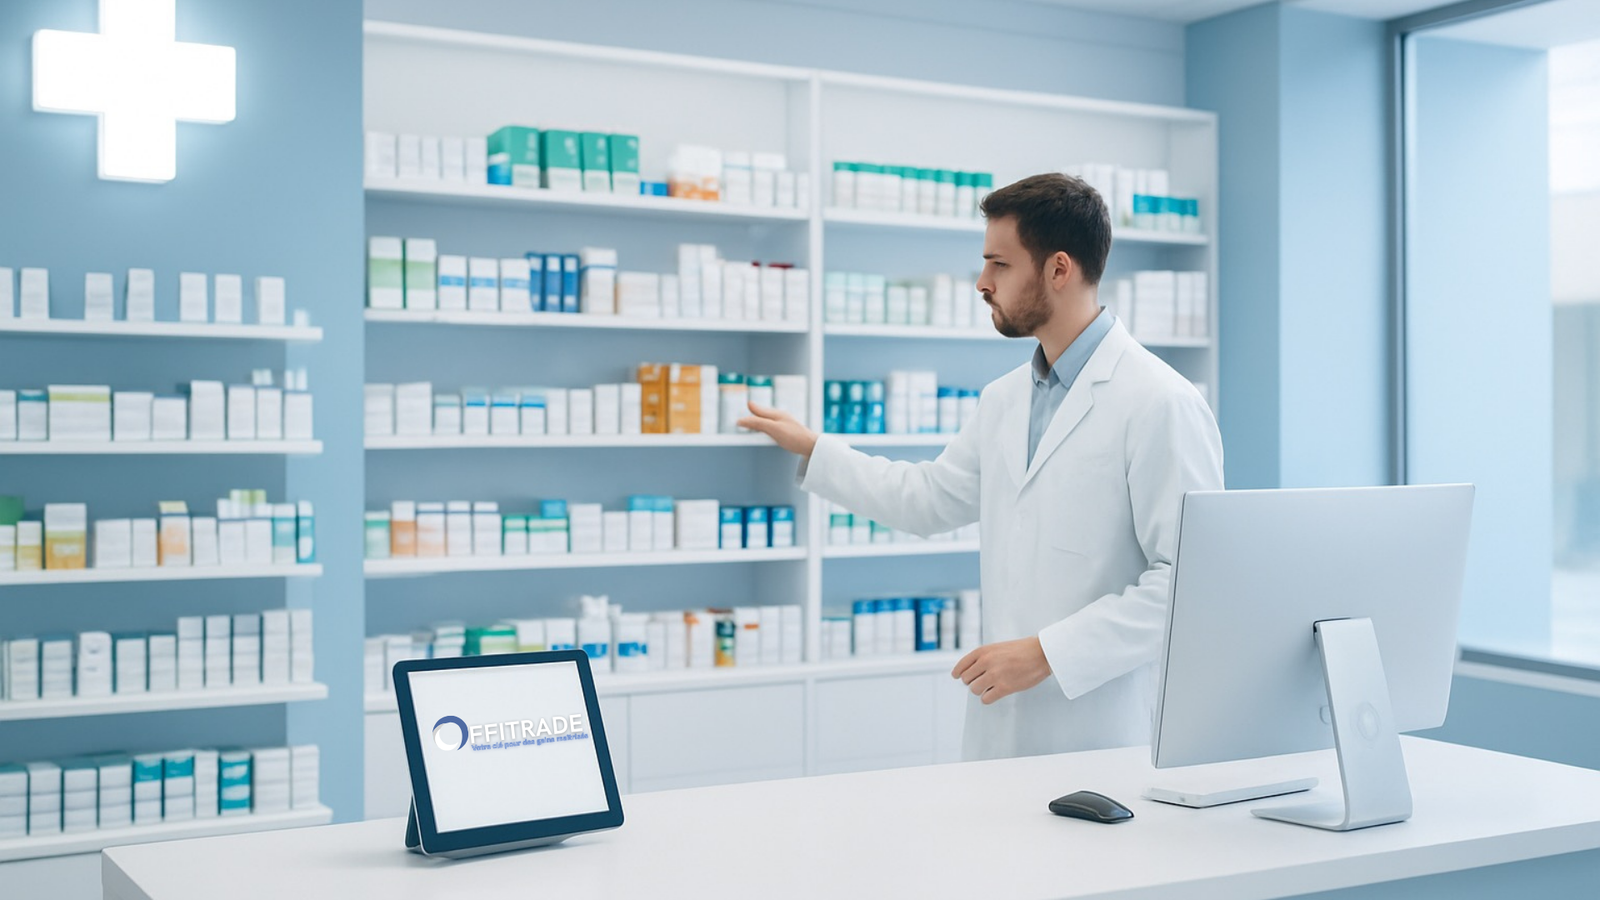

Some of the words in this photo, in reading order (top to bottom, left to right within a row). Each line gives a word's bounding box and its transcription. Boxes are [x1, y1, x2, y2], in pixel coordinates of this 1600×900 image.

[492, 741, 503, 749] clé
[504, 741, 521, 749] pour
[536, 737, 555, 746] gains
